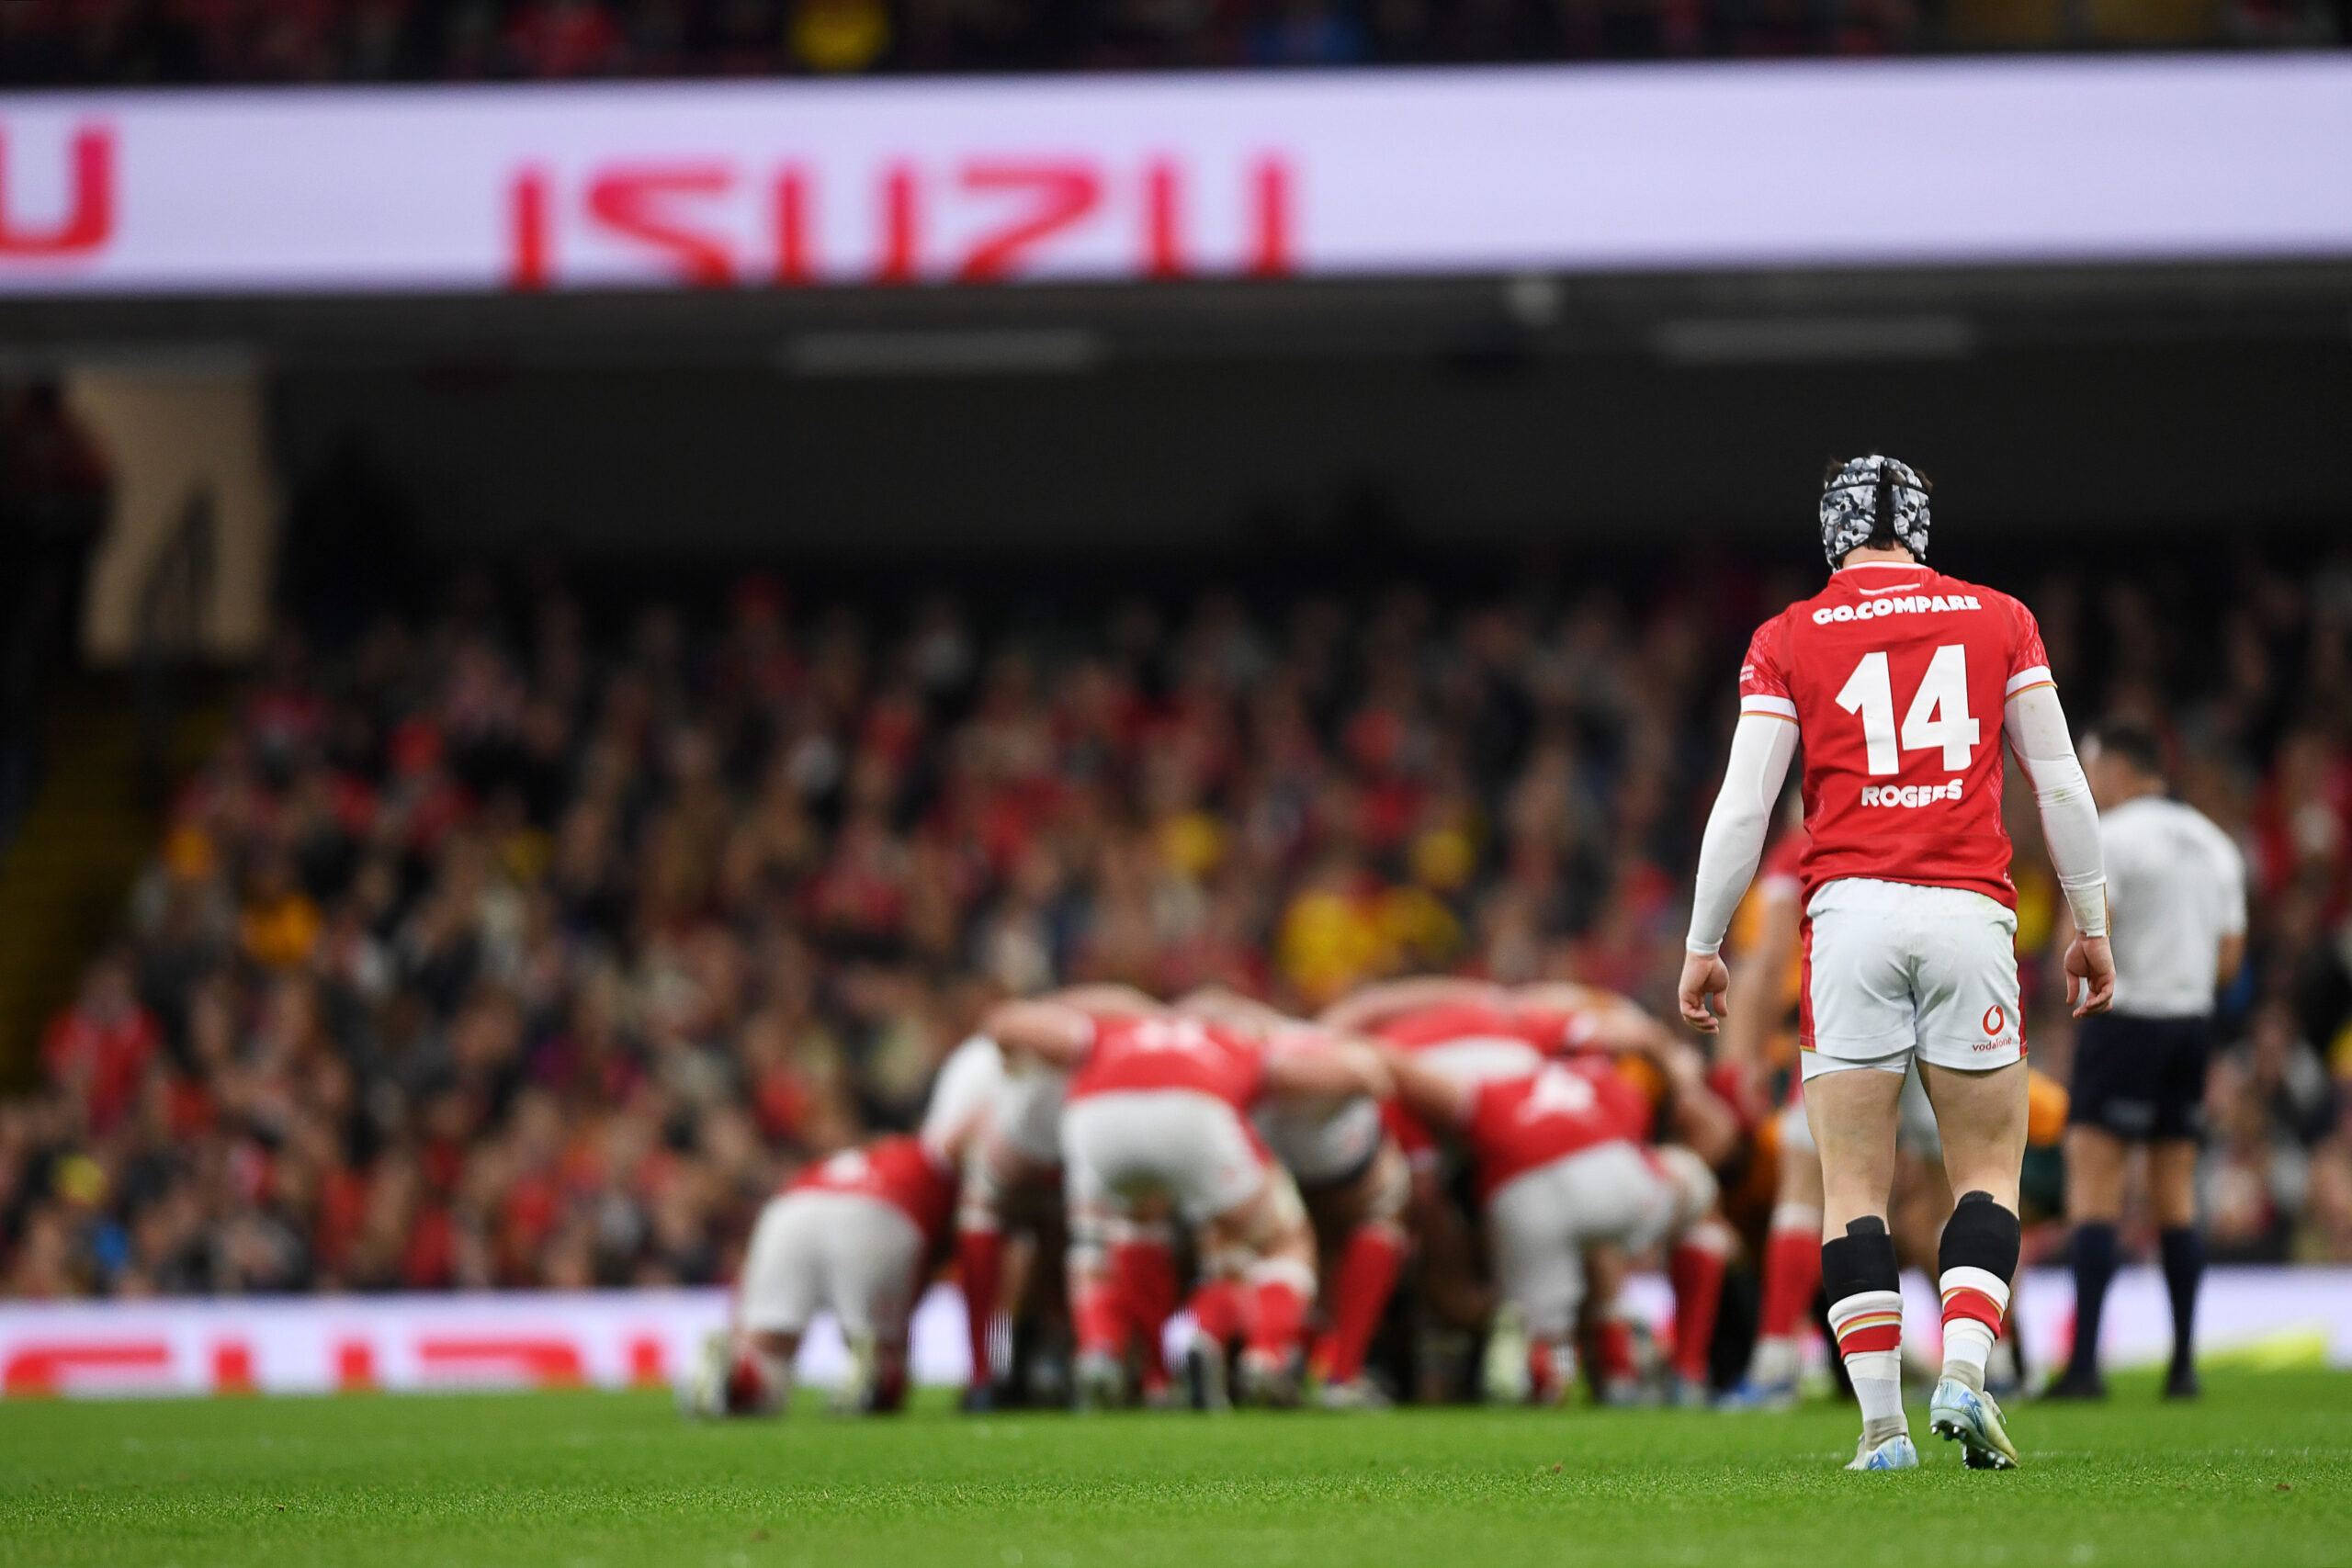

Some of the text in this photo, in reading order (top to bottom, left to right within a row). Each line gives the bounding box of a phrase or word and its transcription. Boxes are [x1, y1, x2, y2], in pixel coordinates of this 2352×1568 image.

[506, 151, 1300, 288] ISUZU
[1812, 595, 1982, 625] GO.COMPARE
[1835, 644, 1980, 776] 14
